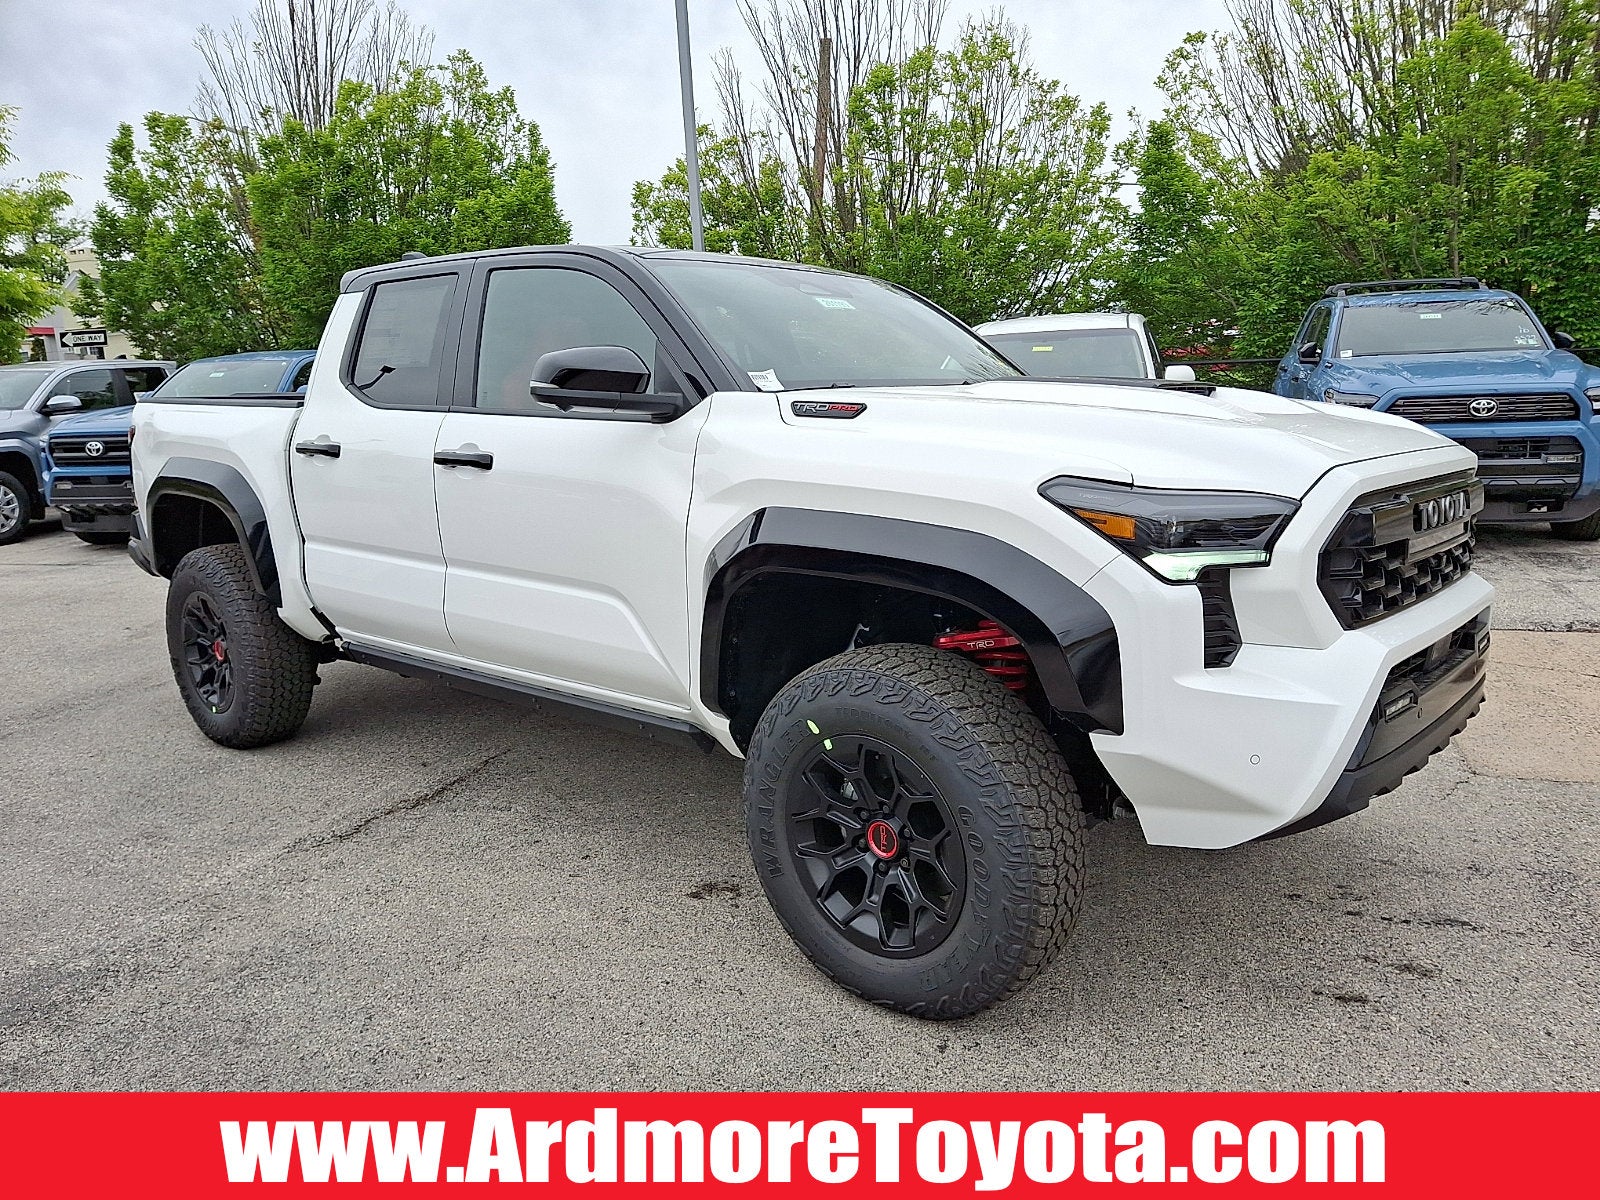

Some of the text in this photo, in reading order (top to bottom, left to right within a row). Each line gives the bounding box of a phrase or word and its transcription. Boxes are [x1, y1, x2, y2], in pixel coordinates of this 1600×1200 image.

[793, 402, 859, 413] TRD PRO
[1419, 491, 1469, 531] TOYOTA
[967, 641, 994, 649] TRD
[757, 718, 812, 879] WRANGLER
[879, 825, 888, 851] TRD
[918, 804, 992, 992] GOODYEAR
